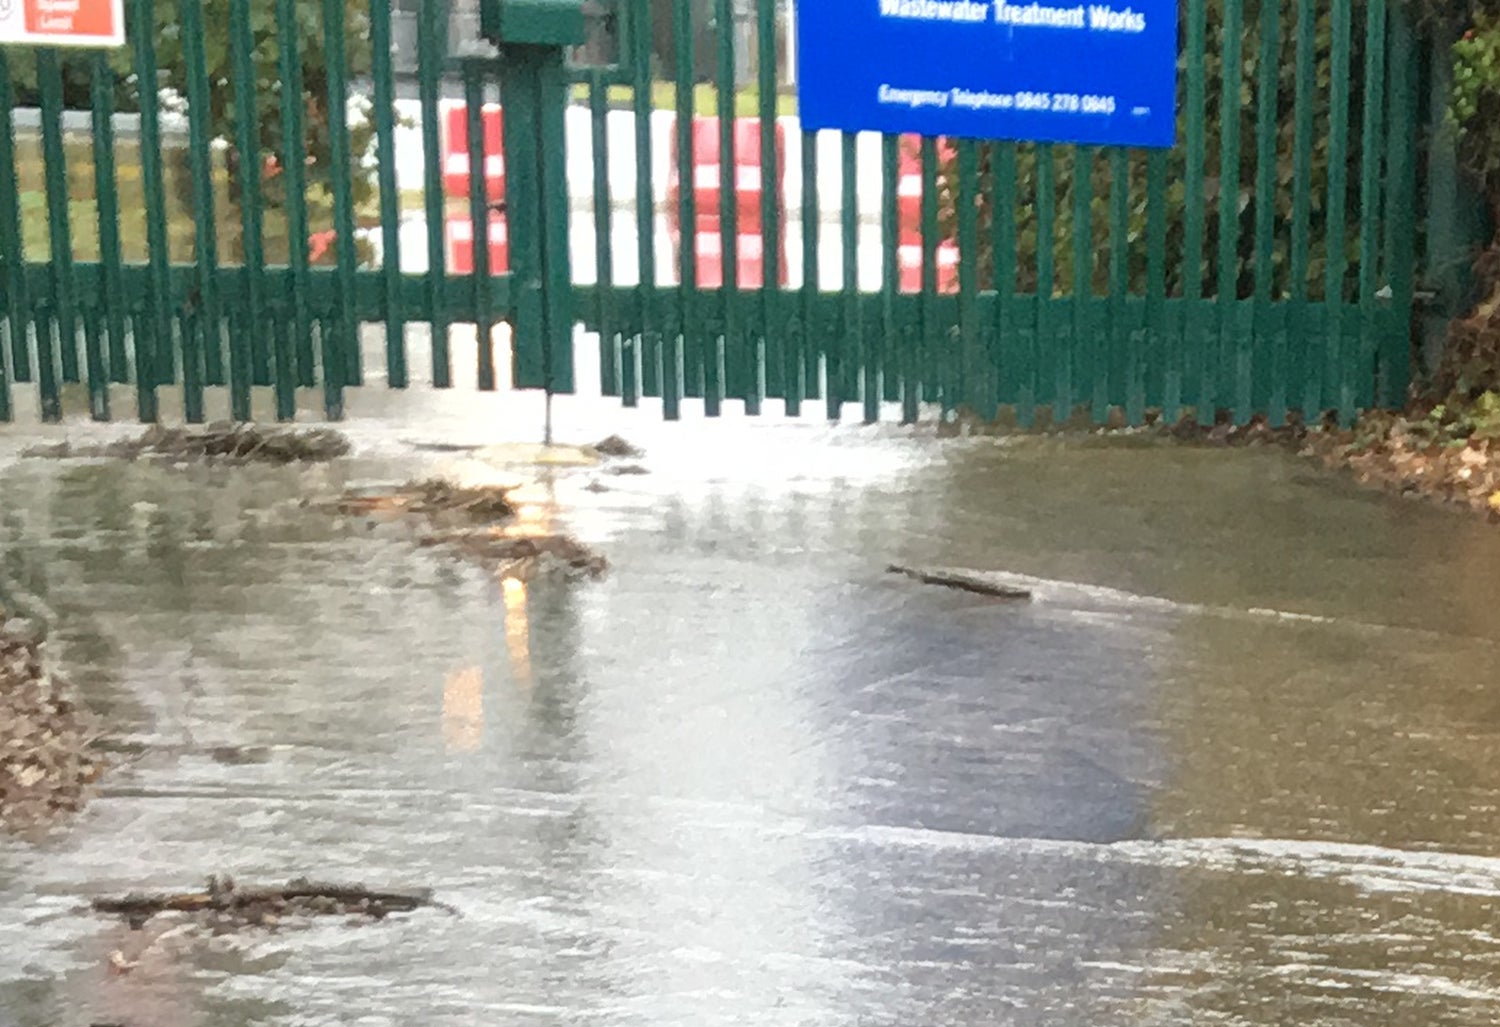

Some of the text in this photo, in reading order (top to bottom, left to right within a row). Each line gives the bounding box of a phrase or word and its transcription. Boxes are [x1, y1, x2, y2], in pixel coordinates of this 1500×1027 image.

[879, 0, 1146, 33] Wastewater Treatment Works
[878, 84, 949, 107] Emergency
[950, 87, 1013, 110] Telephone
[1015, 90, 1050, 111] 0845
[1051, 92, 1079, 112] 278
